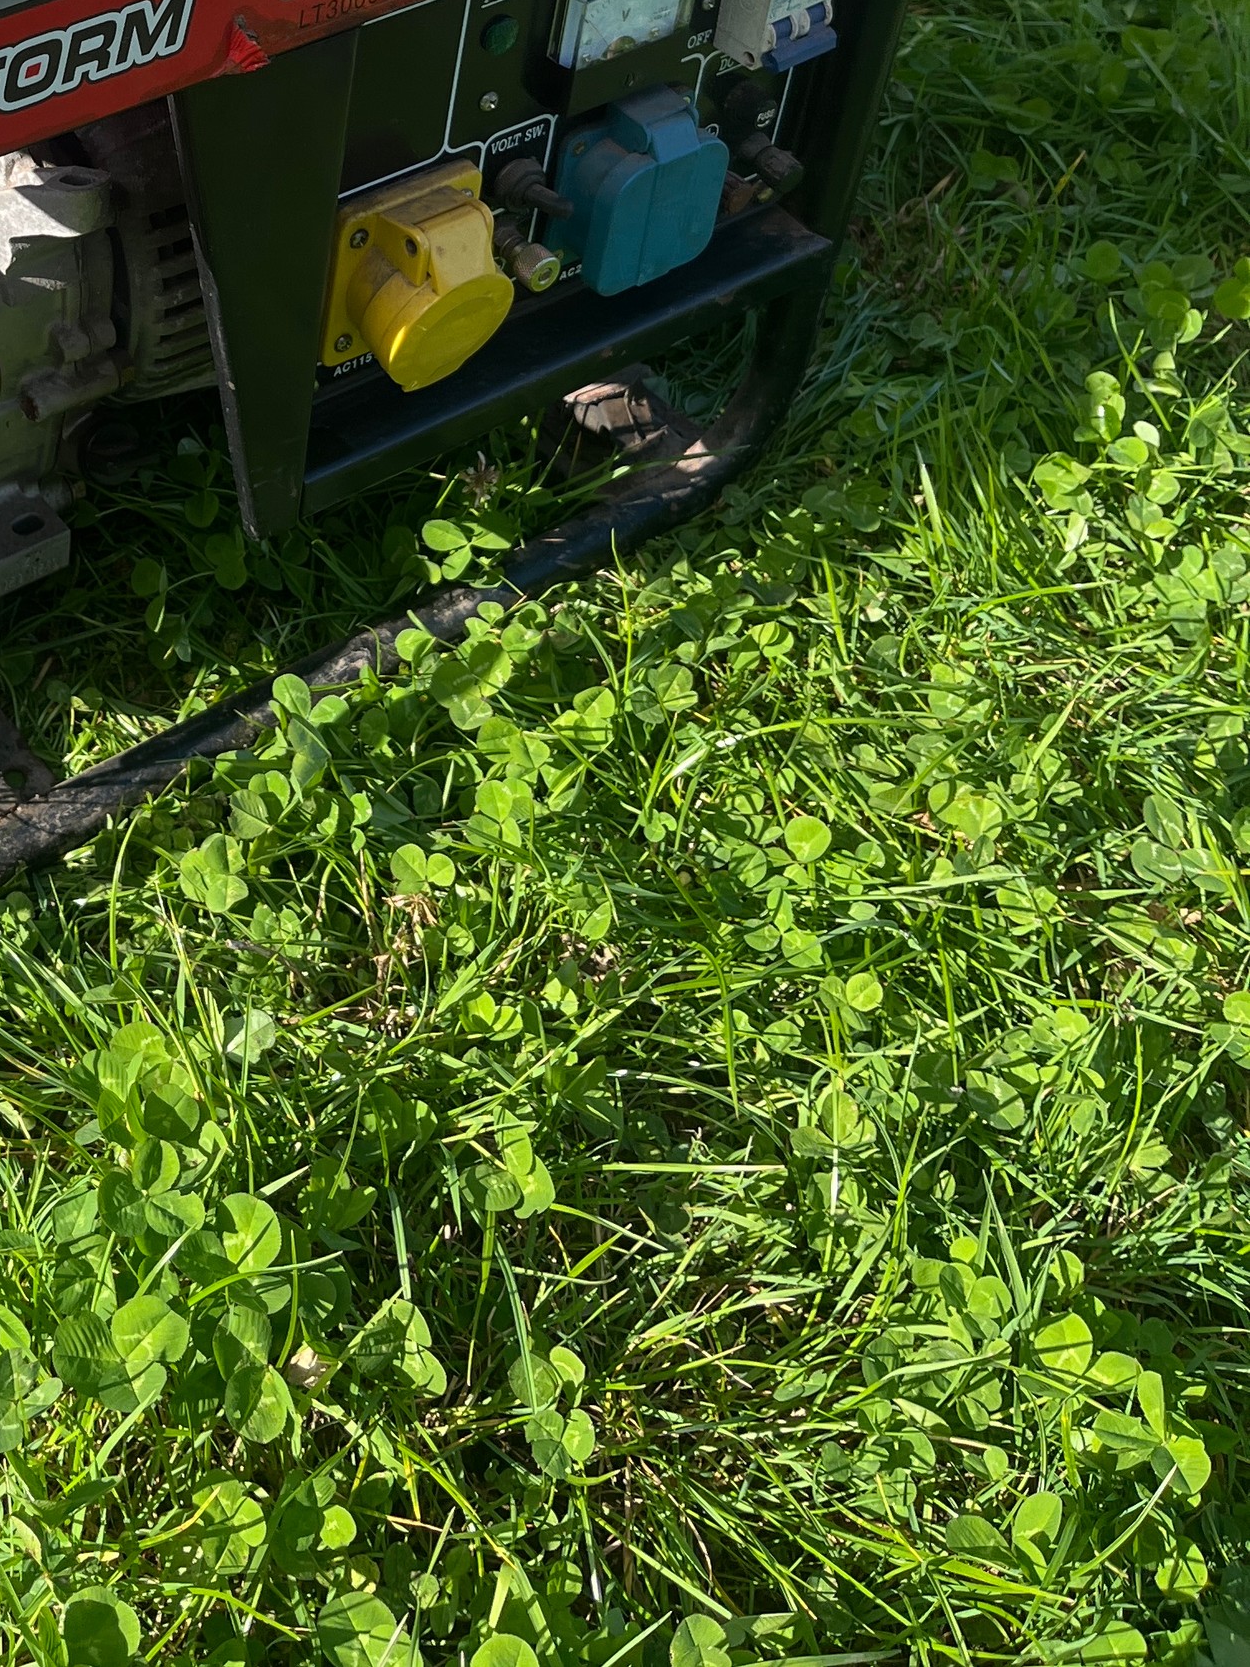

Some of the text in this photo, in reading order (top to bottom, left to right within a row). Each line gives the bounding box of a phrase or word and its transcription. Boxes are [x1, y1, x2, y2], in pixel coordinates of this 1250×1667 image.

[687, 29, 712, 49] OFF
[756, 108, 776, 122] FUSE
[490, 133, 522, 155] VOLT
[559, 264, 583, 281] AC2
[333, 351, 373, 377] AC115
